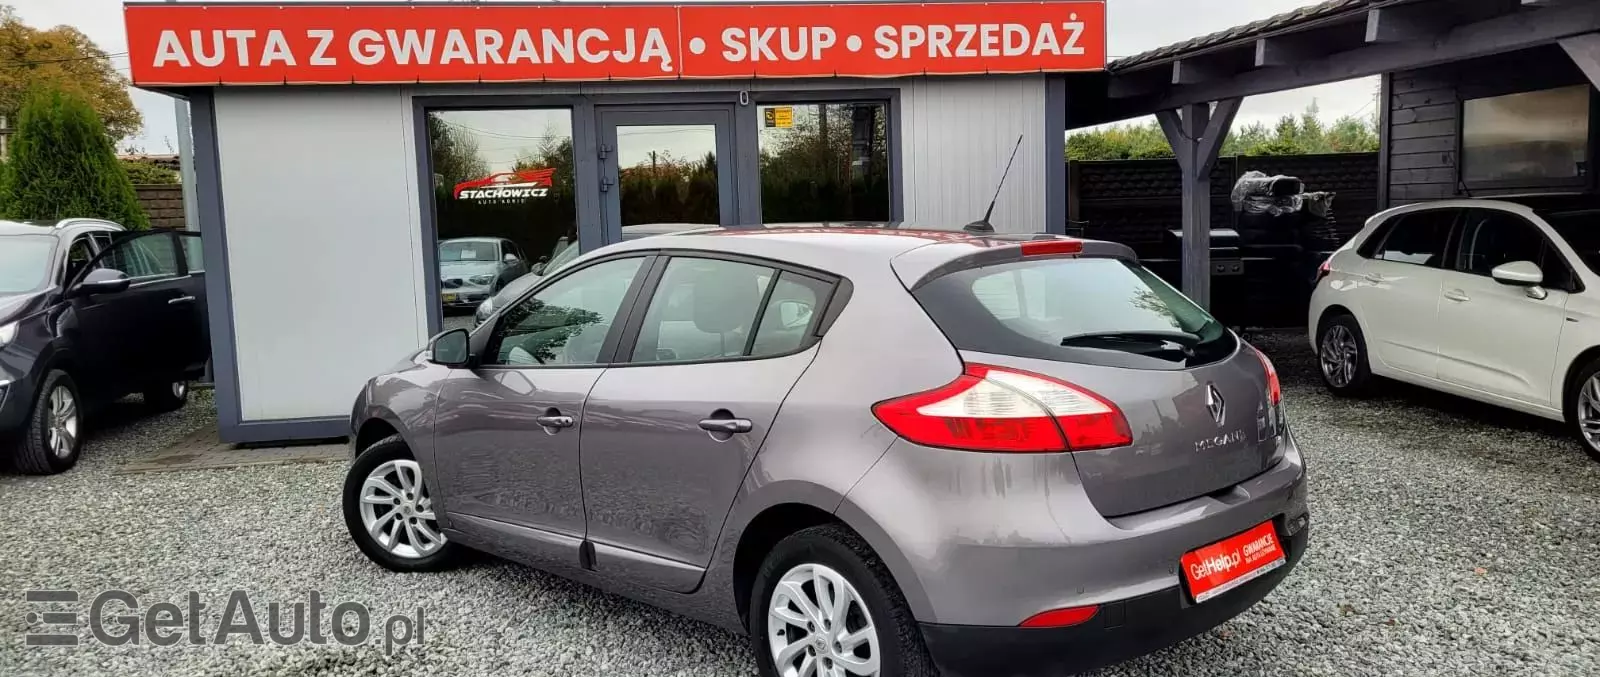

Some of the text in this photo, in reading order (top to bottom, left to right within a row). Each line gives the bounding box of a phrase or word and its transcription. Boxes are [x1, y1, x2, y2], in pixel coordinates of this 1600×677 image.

[153, 13, 1085, 72] AUTA Z GWARANCJĄ SKUP SPRZEDAŻ
[459, 188, 549, 199] STACHOWICZ
[1190, 548, 1241, 581] GetHelp.pl
